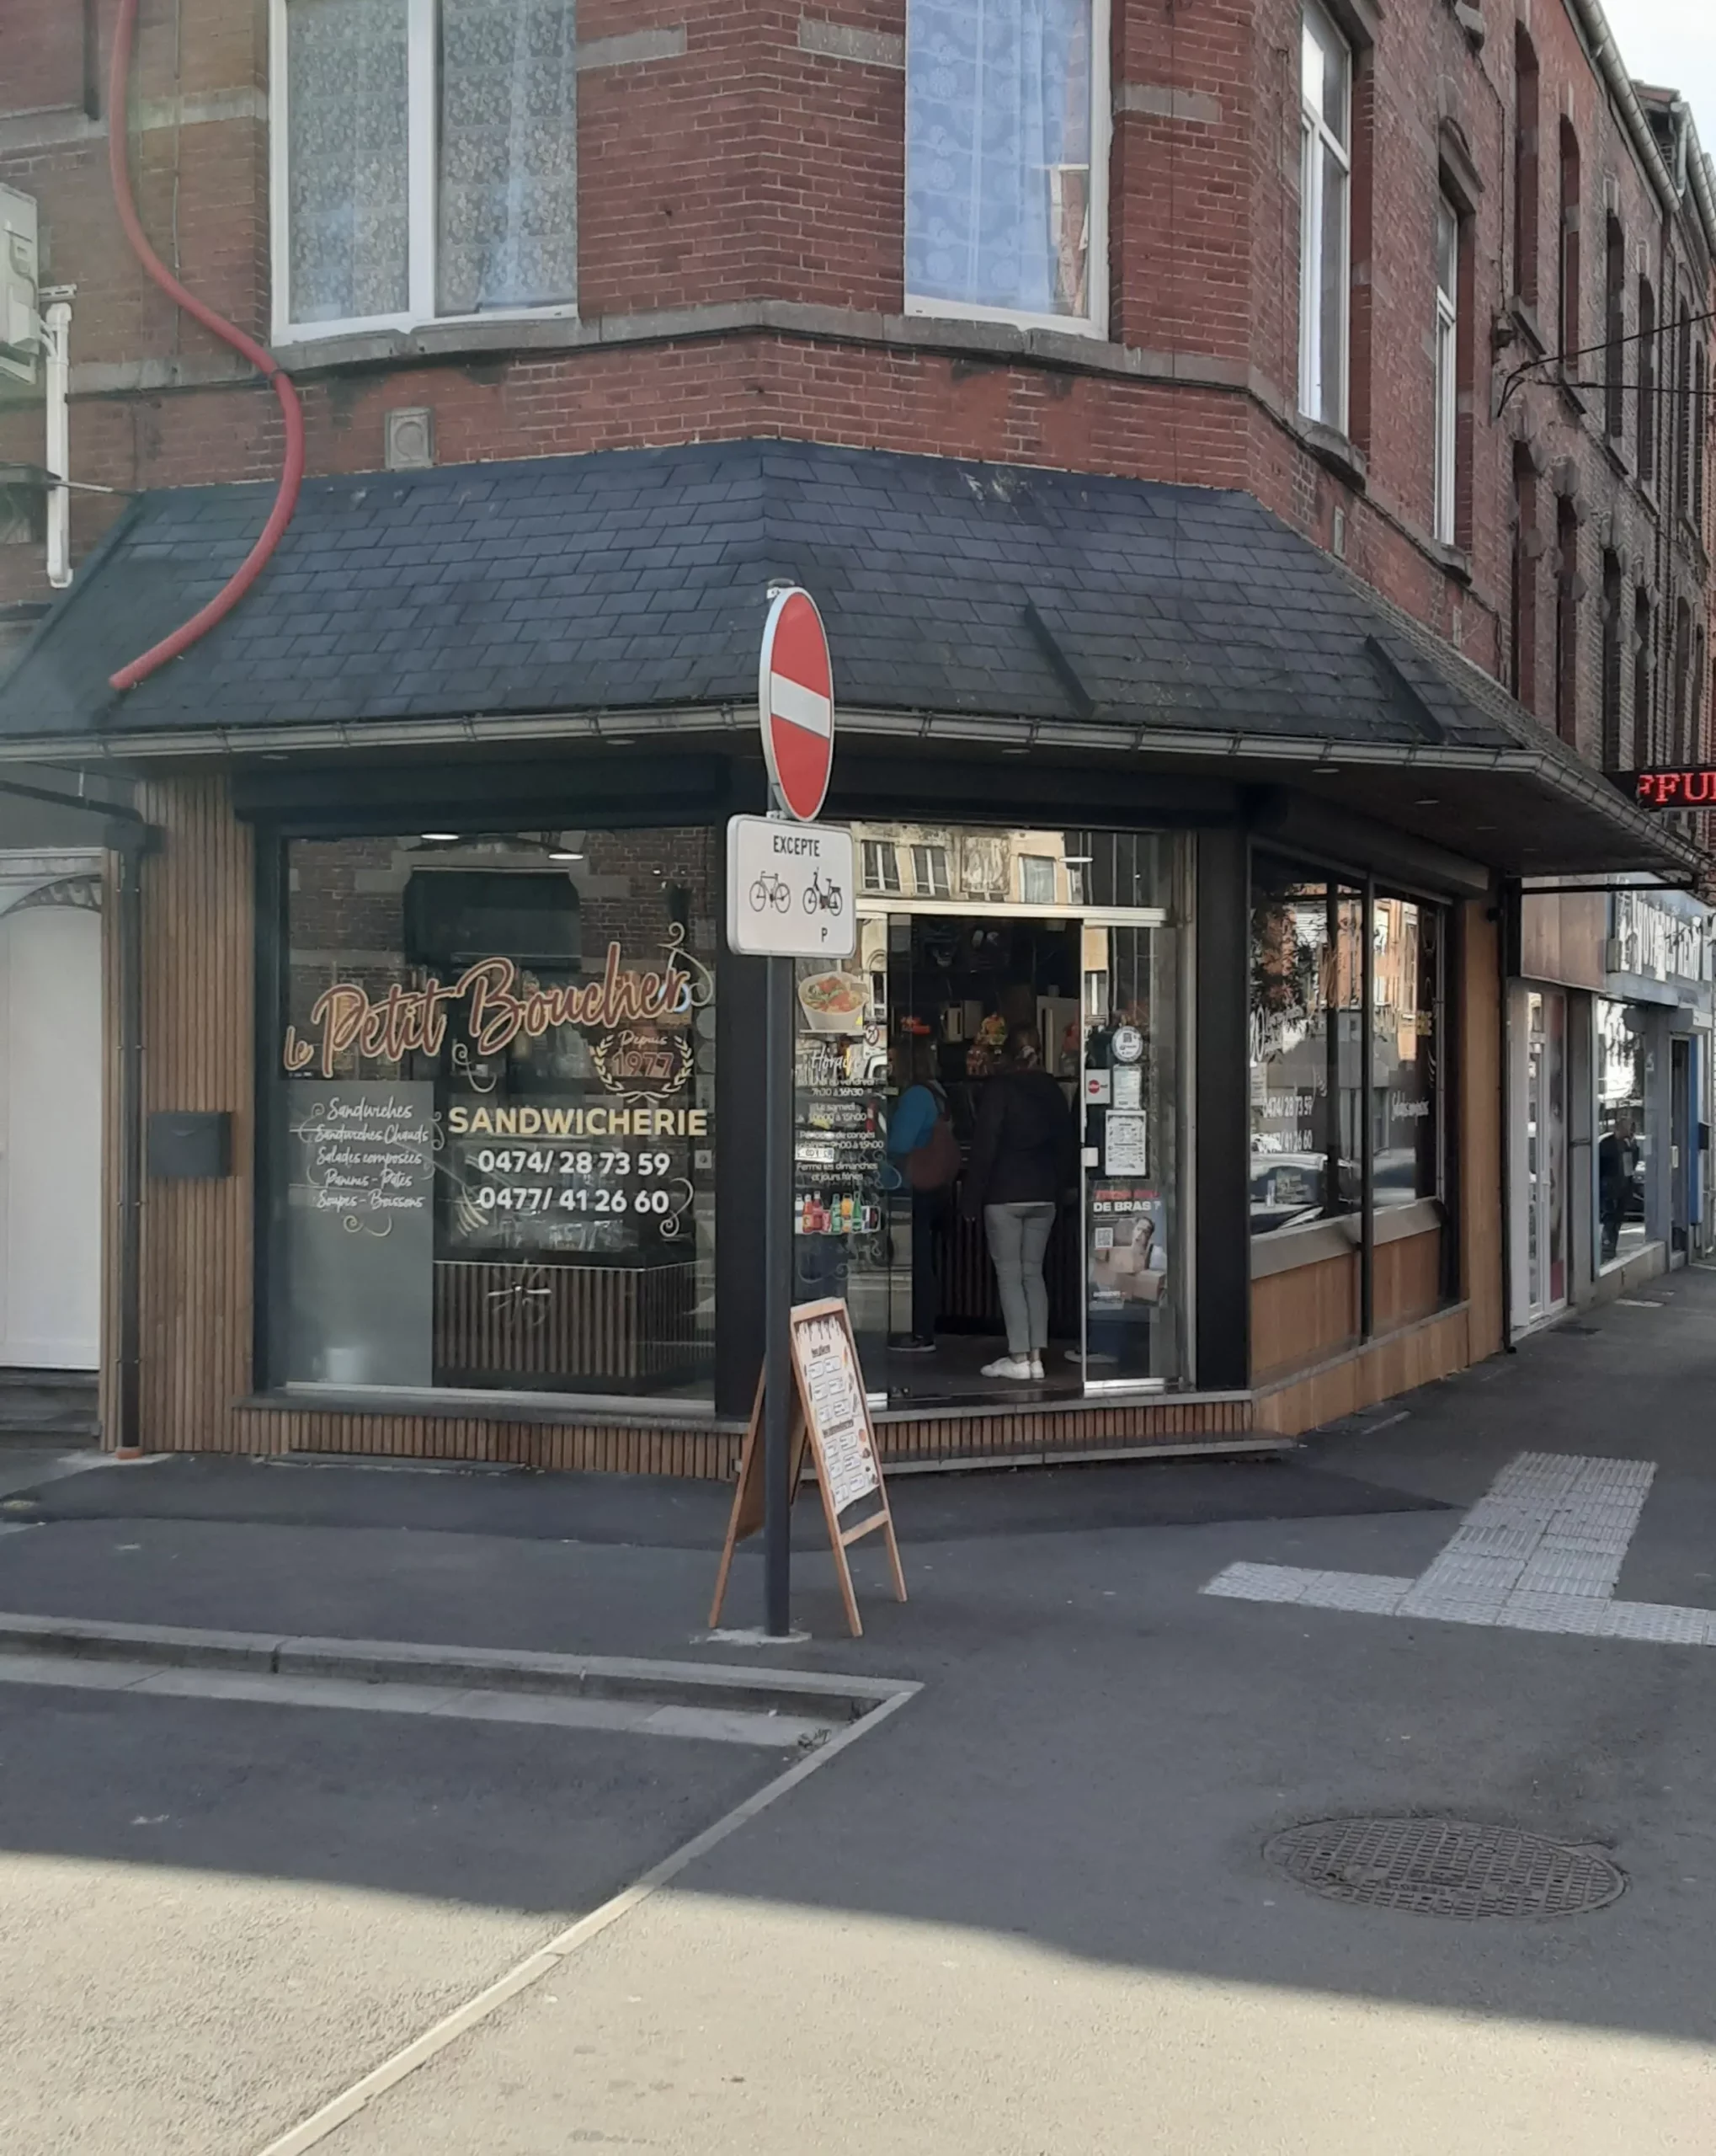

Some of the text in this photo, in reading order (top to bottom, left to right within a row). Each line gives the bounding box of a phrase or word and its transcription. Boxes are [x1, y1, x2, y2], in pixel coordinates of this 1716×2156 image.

[773, 835, 820, 857] EXCEPTE
[821, 927, 829, 942] P
[312, 978, 456, 1078] Petit
[451, 941, 692, 1055] Boucher
[618, 1030, 669, 1049] Depuis
[612, 1049, 675, 1077] 1977
[327, 1096, 413, 1122] Sandwiches
[1284, 1096, 1295, 1117] 28
[448, 1106, 709, 1136] SANDWICHERIE
[315, 1123, 429, 1145] Sandwiches Chauds
[1303, 1129, 1313, 1150] 60
[317, 1146, 361, 1166] Salades
[477, 1149, 672, 1177] 0474/ 28 73 59
[317, 1189, 358, 1213] Soupes
[368, 1188, 426, 1210] Boissons
[478, 1187, 670, 1214] 0477/ 41 26 60
[1093, 1200, 1162, 1213] DE BRAS ?
